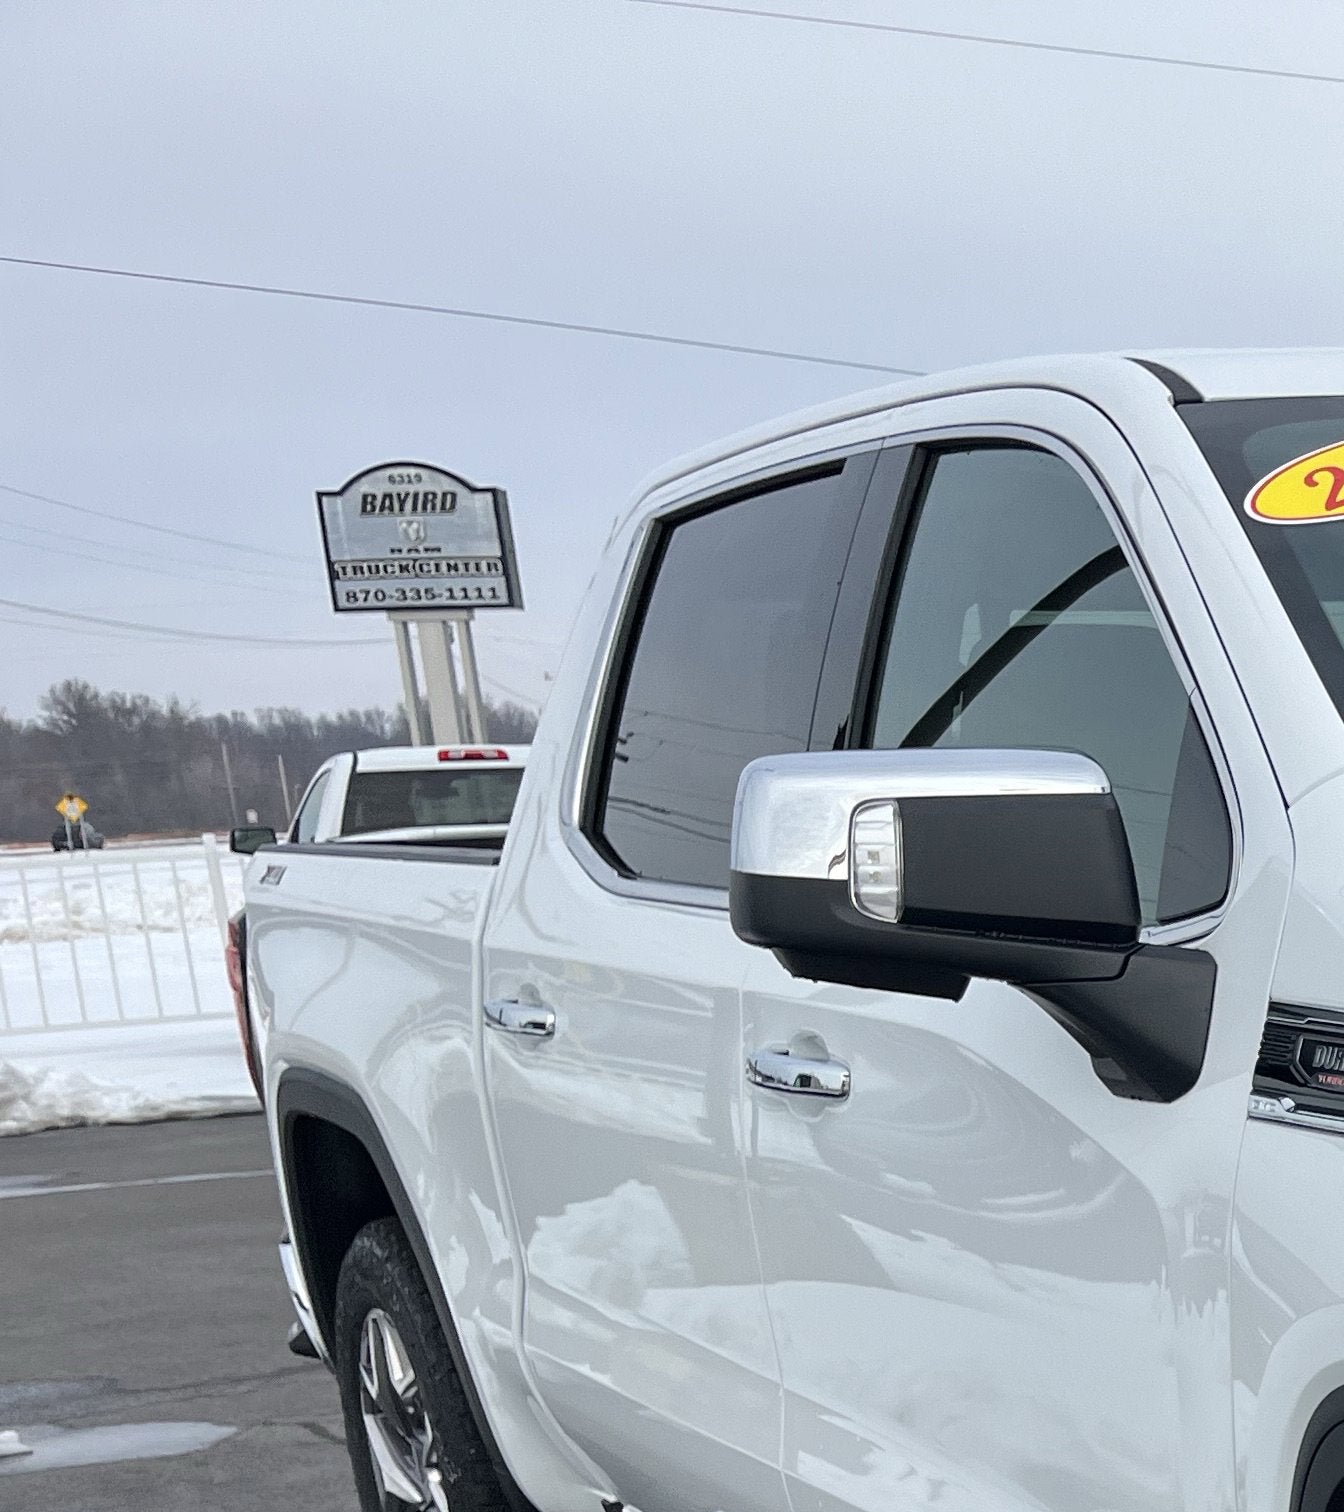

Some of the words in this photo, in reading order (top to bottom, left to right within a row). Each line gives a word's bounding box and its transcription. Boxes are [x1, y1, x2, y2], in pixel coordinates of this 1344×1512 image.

[361, 491, 457, 514] BAYIRD
[338, 564, 412, 577] TRUCK
[419, 562, 500, 574] CENTER
[345, 586, 499, 604] 870-335-1111
